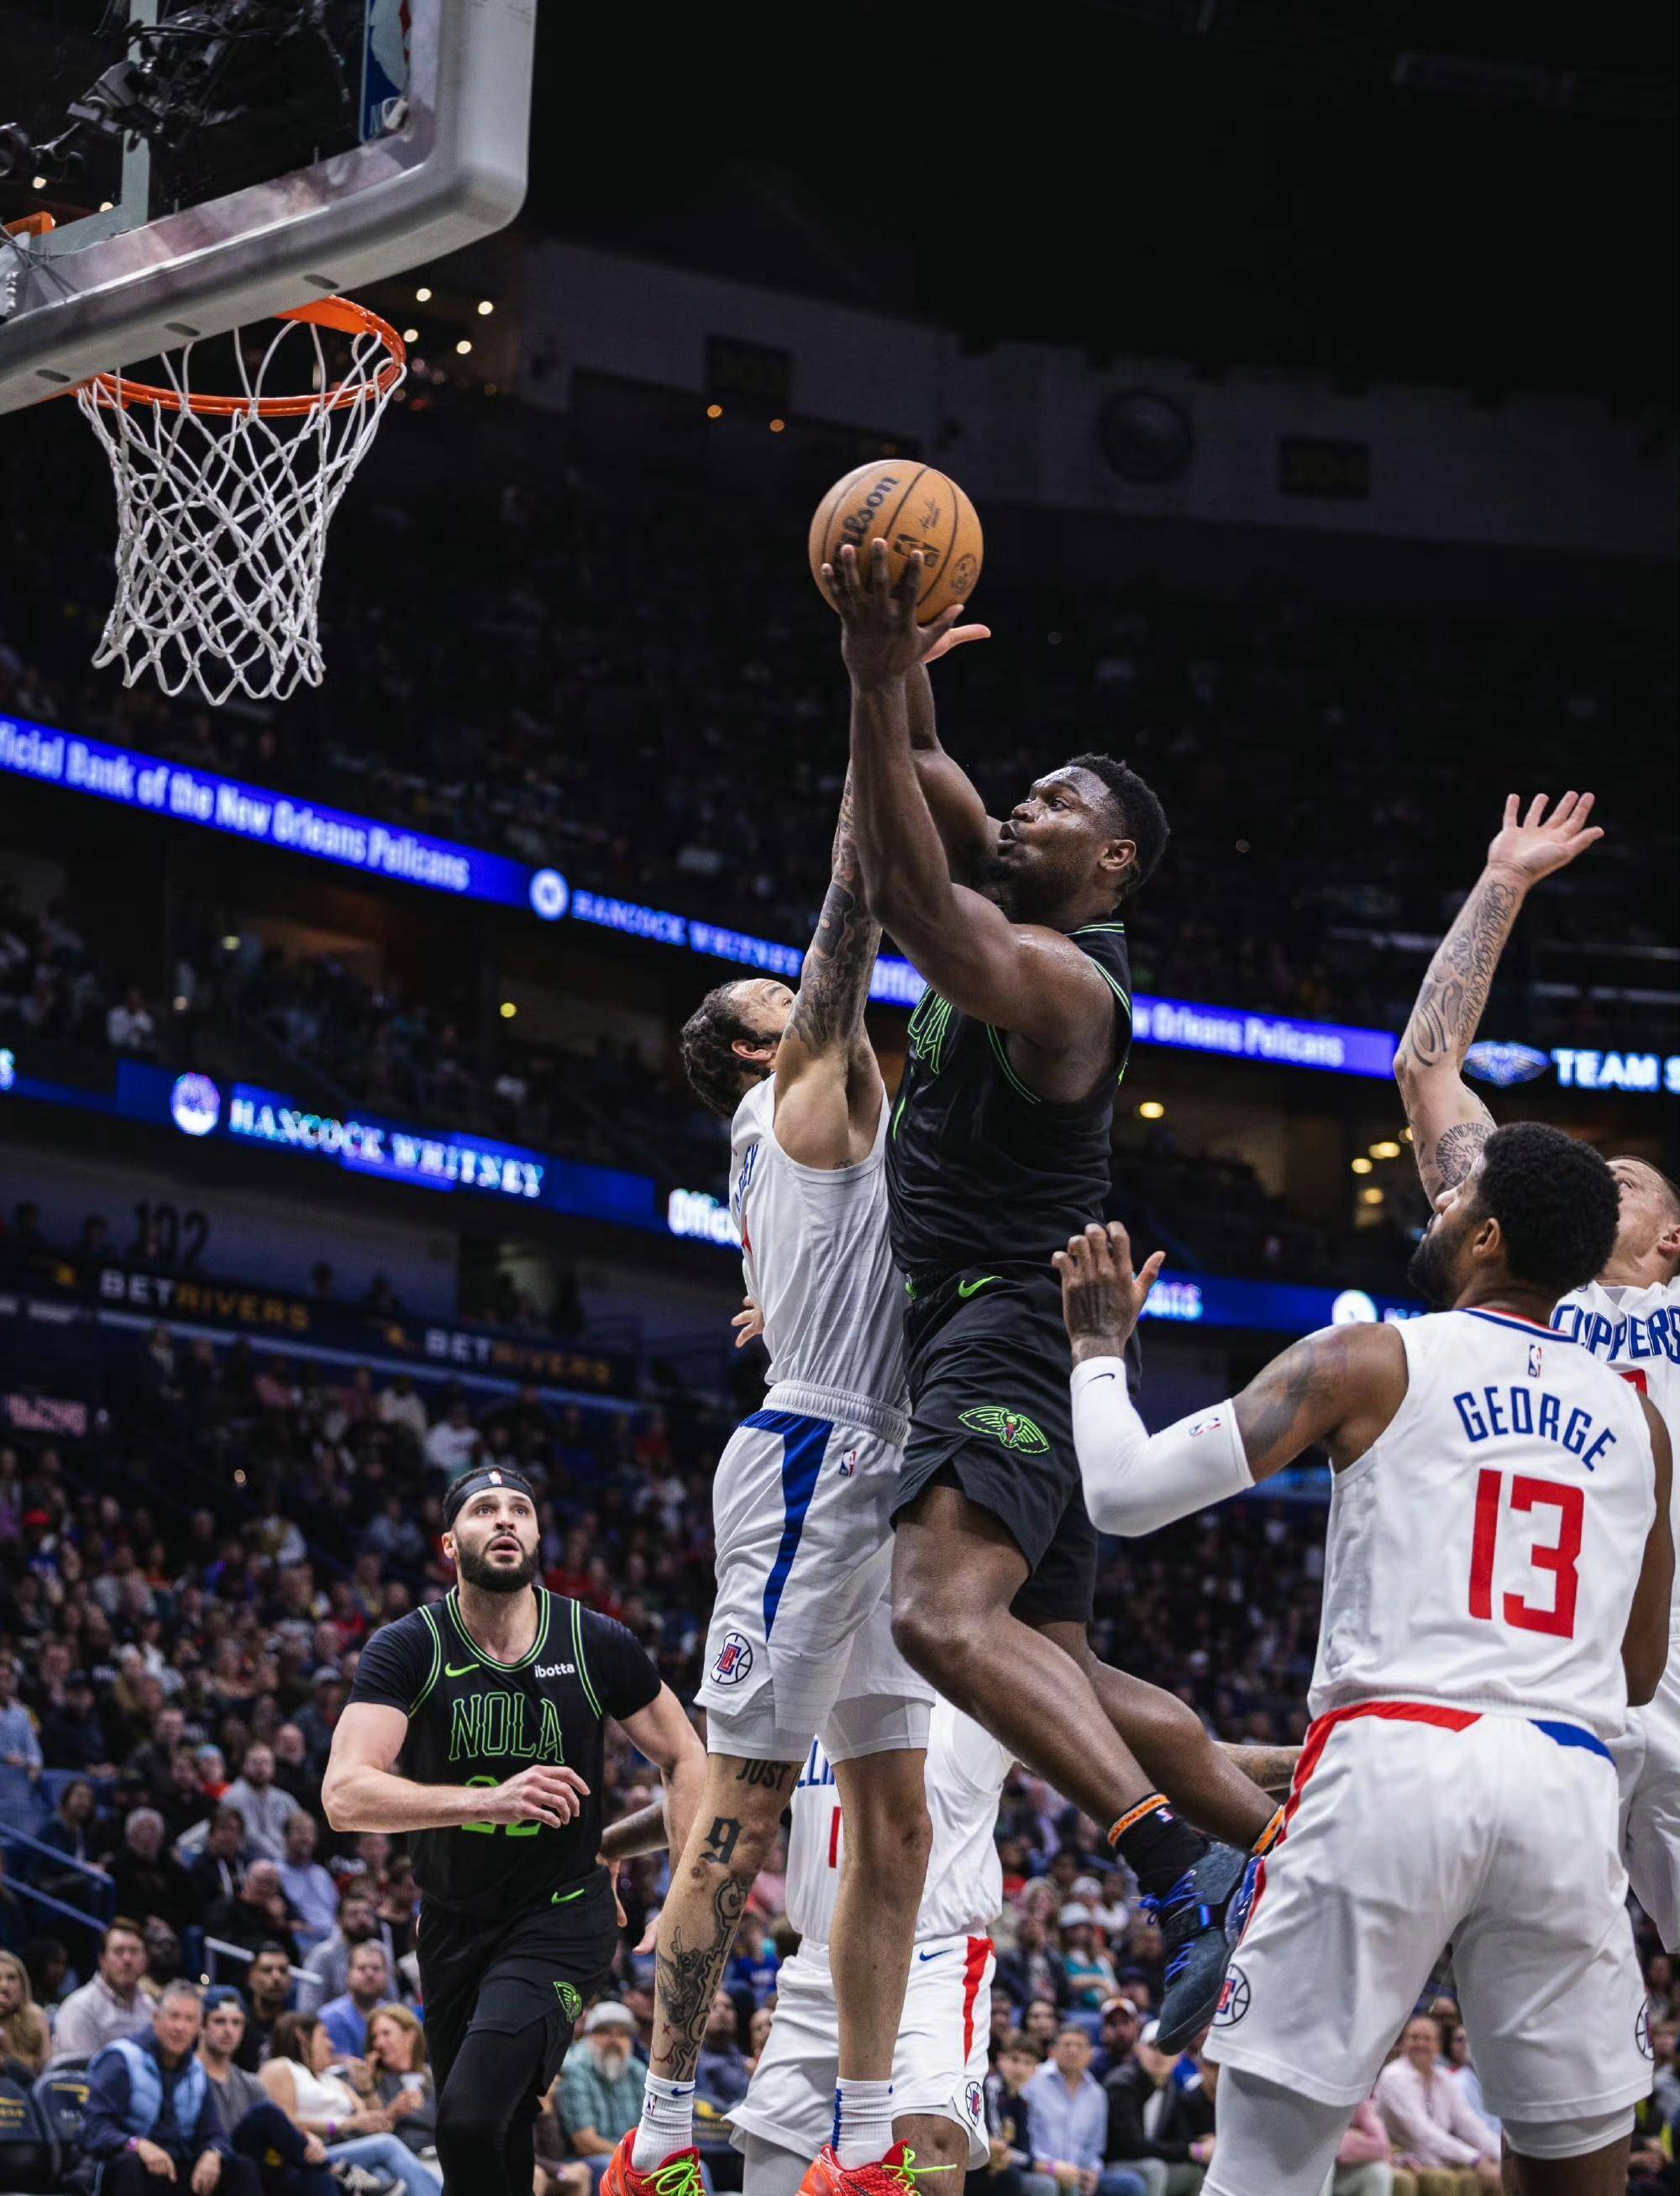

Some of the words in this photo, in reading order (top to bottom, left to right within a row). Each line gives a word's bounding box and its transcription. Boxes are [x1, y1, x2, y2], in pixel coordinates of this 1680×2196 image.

[835, 476, 900, 568] ilson
[66, 740, 136, 800] Bank
[137, 765, 170, 807] of
[170, 771, 214, 821] the
[215, 783, 272, 837] New
[272, 801, 367, 864] Orleans
[367, 827, 470, 891] Pelicans
[1152, 1002, 1243, 1053] Orleans
[1244, 1016, 1344, 1068] Pelicans
[1551, 1048, 1660, 1092] TEAM
[228, 1098, 386, 1164] HANCOCK
[391, 1132, 544, 1198] WHITNEY
[1453, 1386, 1616, 1472] GEORGE
[1468, 1468, 1584, 1640] 13
[534, 1663, 575, 1679] ibotta
[449, 1691, 565, 1765] NOLA
